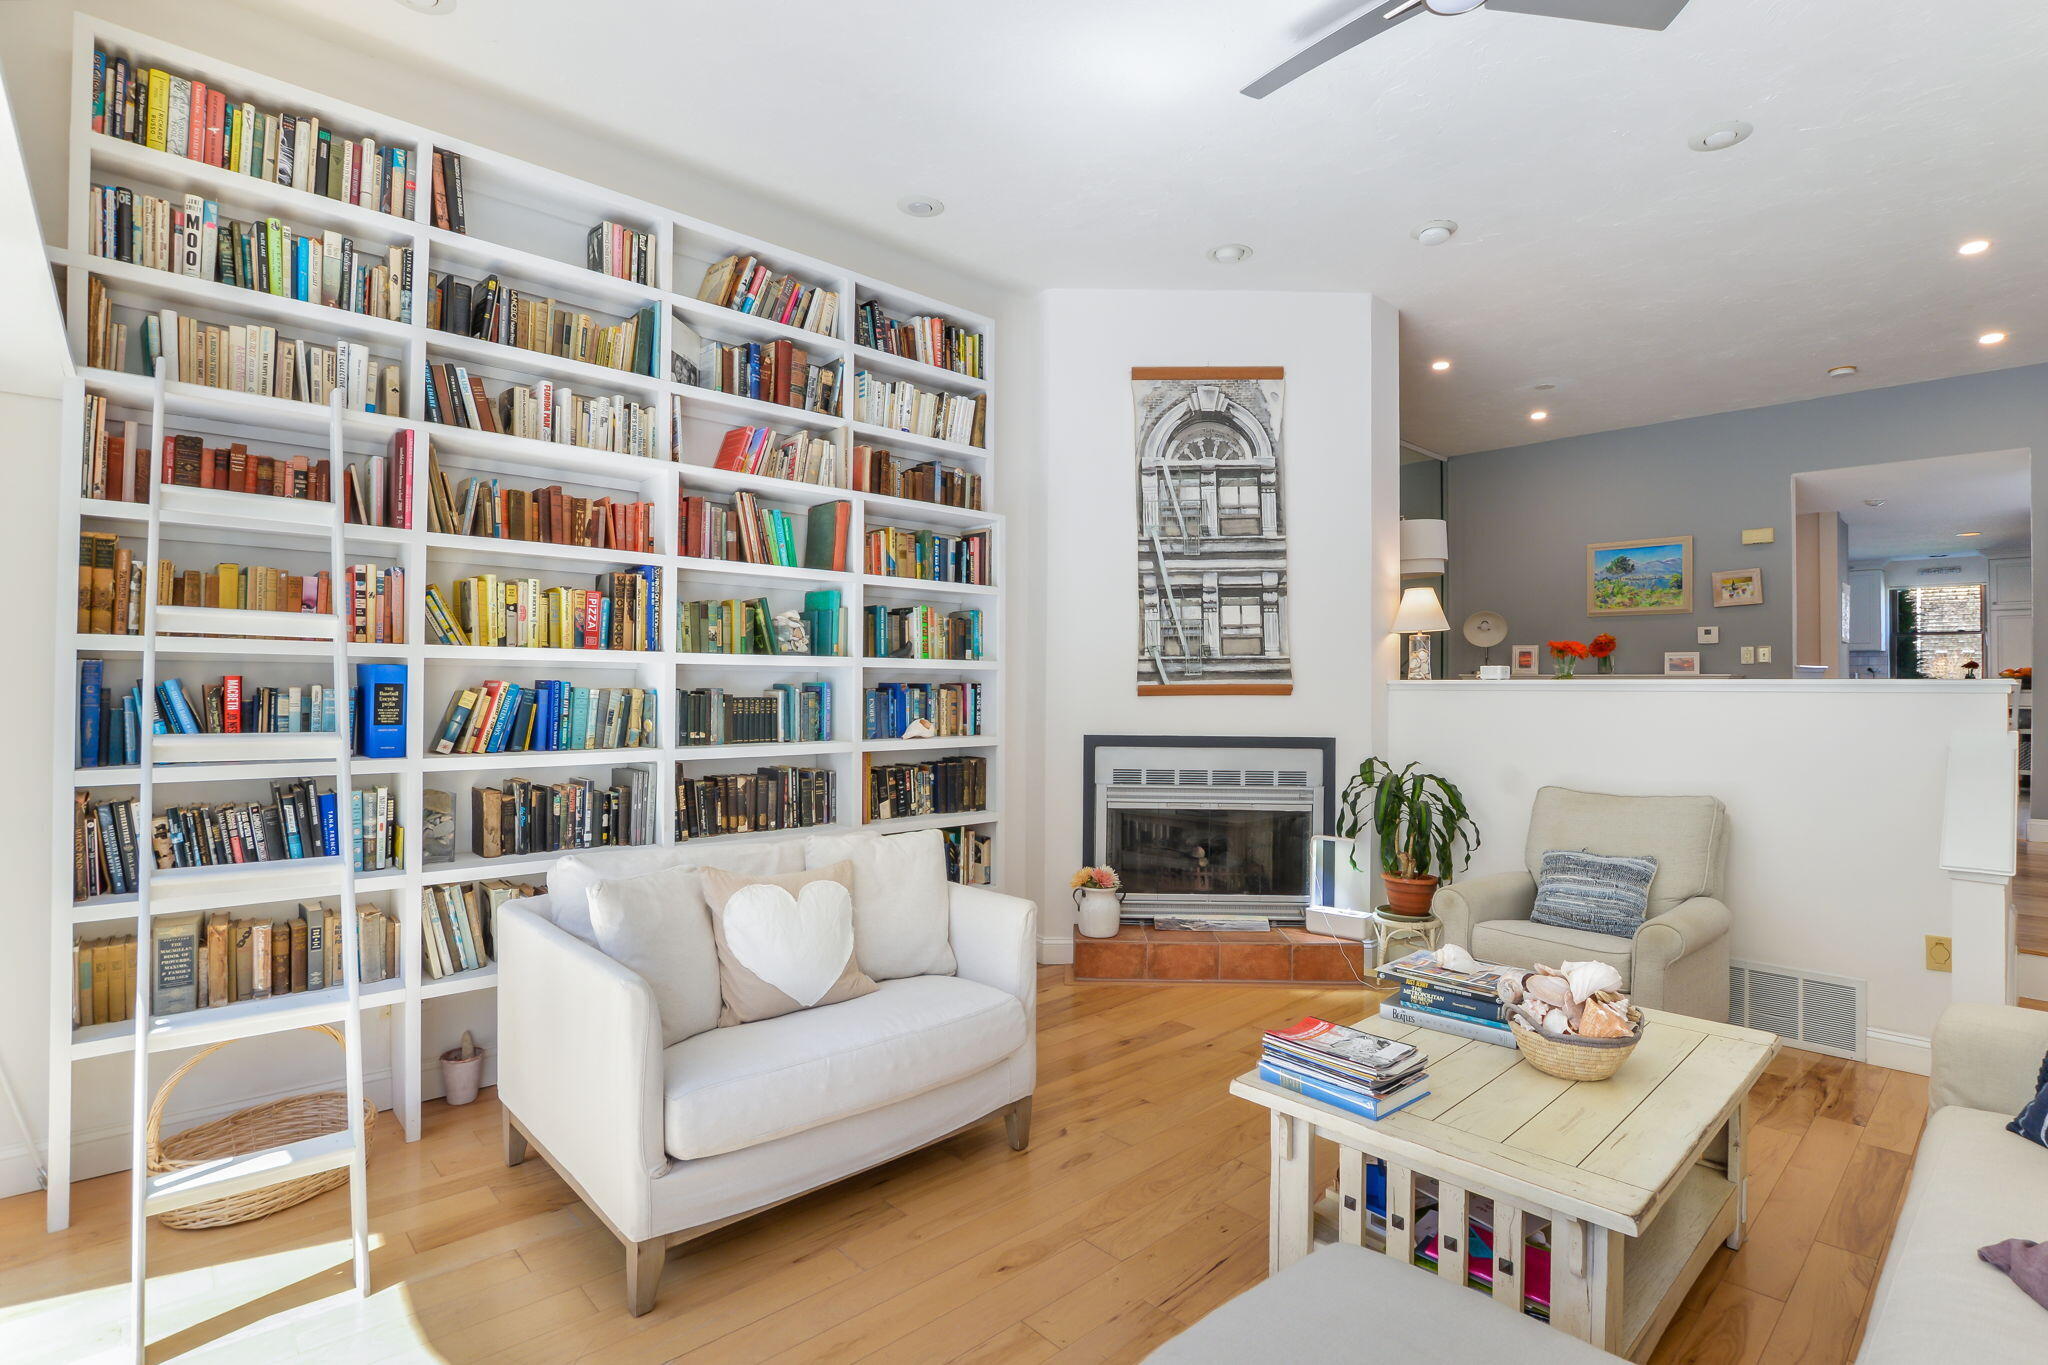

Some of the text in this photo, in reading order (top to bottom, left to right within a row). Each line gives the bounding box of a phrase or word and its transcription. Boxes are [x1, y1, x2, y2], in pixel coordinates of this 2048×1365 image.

[149, 113, 158, 136] RUSSO
[157, 113, 166, 141] RICHARD
[186, 213, 201, 268] MOO
[510, 289, 519, 323] LANCELOT
[427, 383, 438, 408] LEHANE
[542, 384, 553, 429] FLORIDA MAN
[587, 598, 599, 630] PIZZA
[226, 679, 240, 711] MACBETH
[226, 712, 240, 720] JO
[493, 694, 513, 737] THIRTEEN DAYS
[483, 729, 492, 746] COOPER
[679, 785, 688, 811] Baseball
[327, 810, 337, 856] TANA FRENCH
[74, 828, 85, 871] MARCO POLO
[103, 830, 116, 874] TONY HORWITZ
[107, 824, 124, 878] MIDNIGHT RISING
[127, 851, 137, 881] Erik Larson
[167, 968, 192, 976] FAMOUS
[1402, 988, 1445, 1002] METROPOLITAN
[1410, 985, 1422, 993] THE
[1410, 994, 1433, 1004] MUSEUM
[1392, 1008, 1416, 1024] BEATLES
